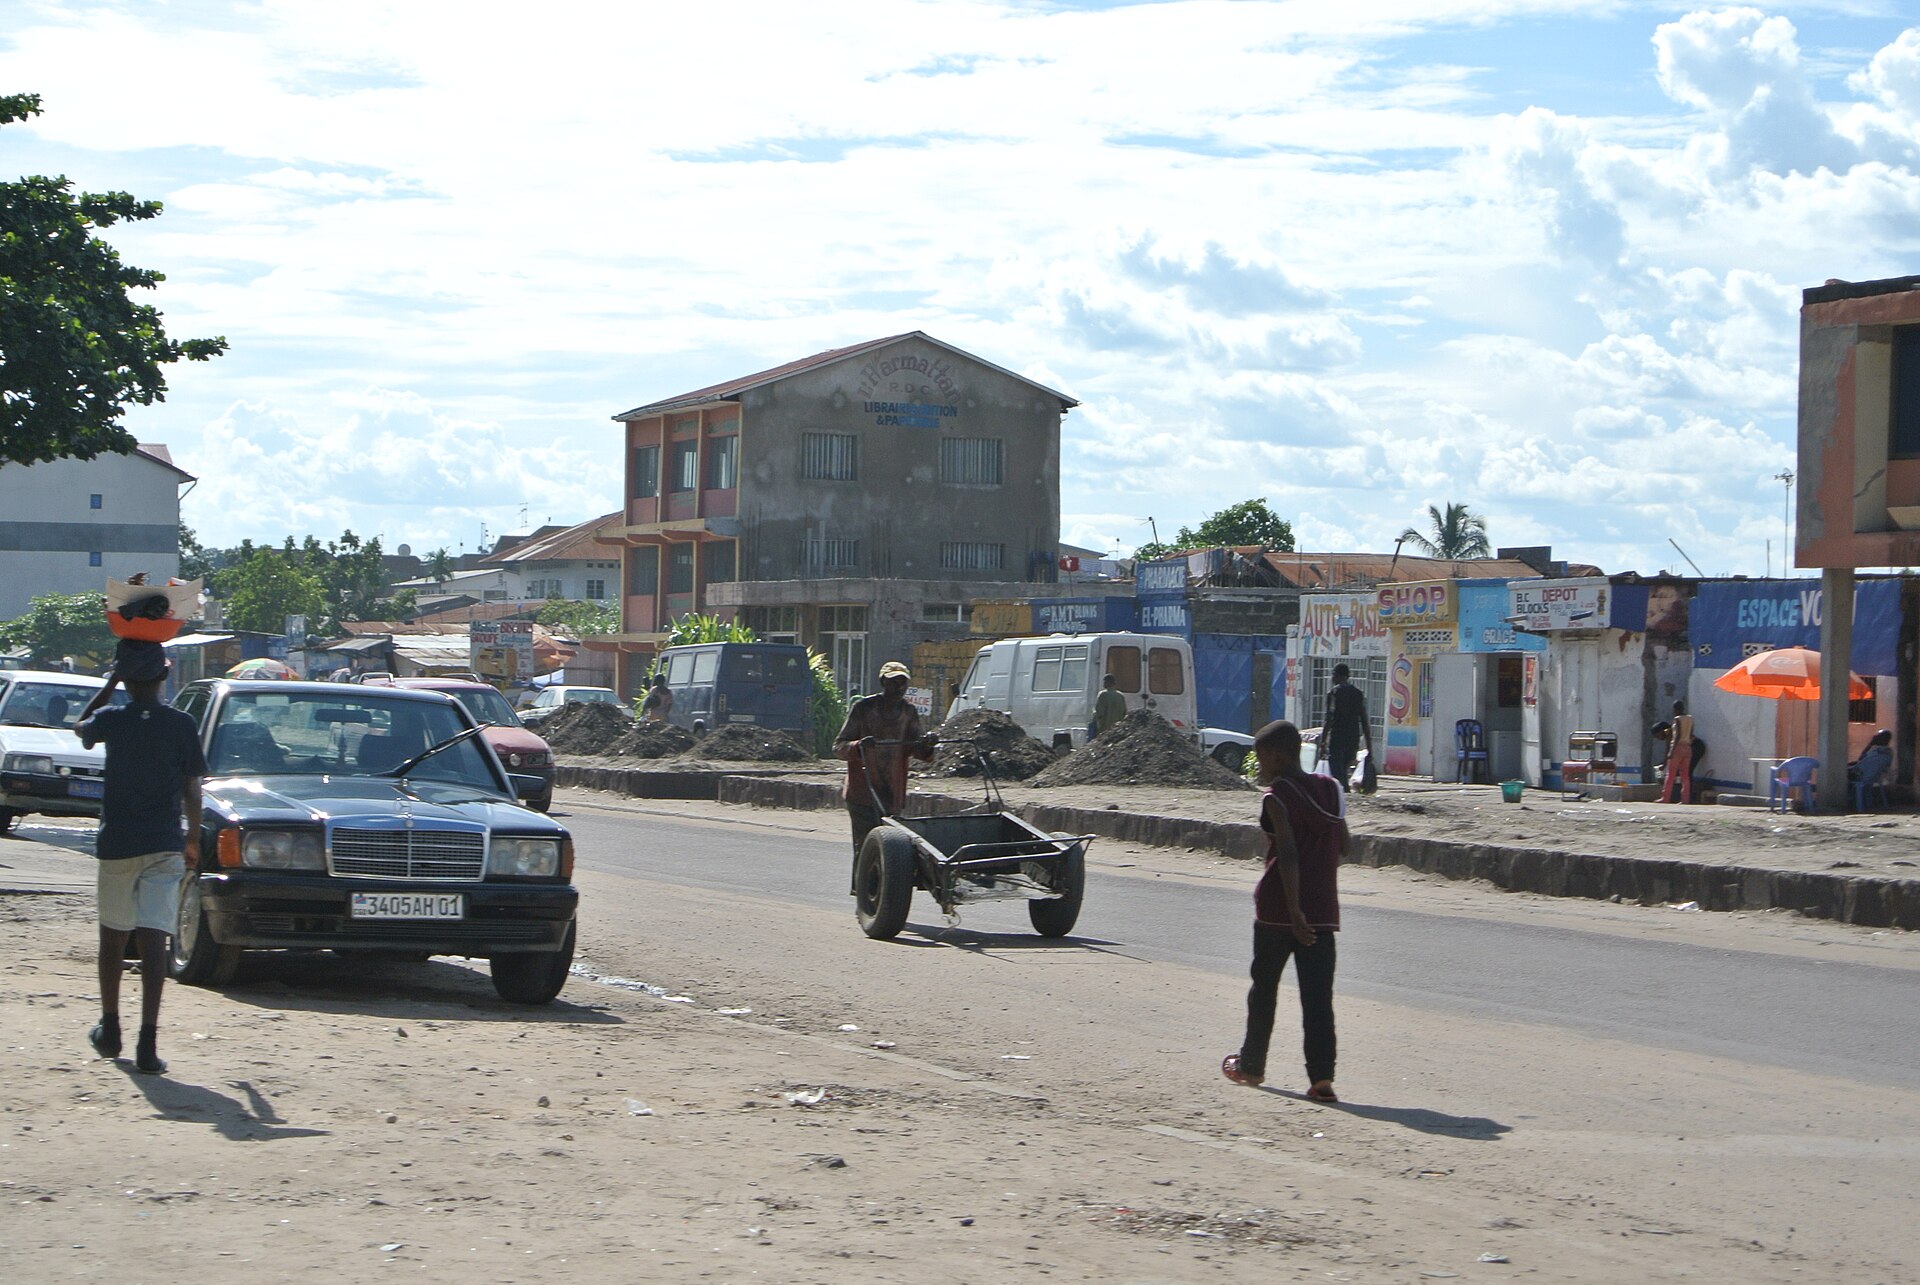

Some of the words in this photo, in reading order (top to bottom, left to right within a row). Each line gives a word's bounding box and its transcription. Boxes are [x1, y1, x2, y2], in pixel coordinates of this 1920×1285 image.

[1378, 585, 1446, 617] SHOP
[1542, 588, 1578, 602] DEPOT
[1302, 599, 1342, 639] AUTO
[1516, 603, 1550, 613] BLOCKS
[1737, 599, 1800, 628] ESPACE
[368, 896, 433, 915] 3405AH
[439, 896, 460, 916] 01
